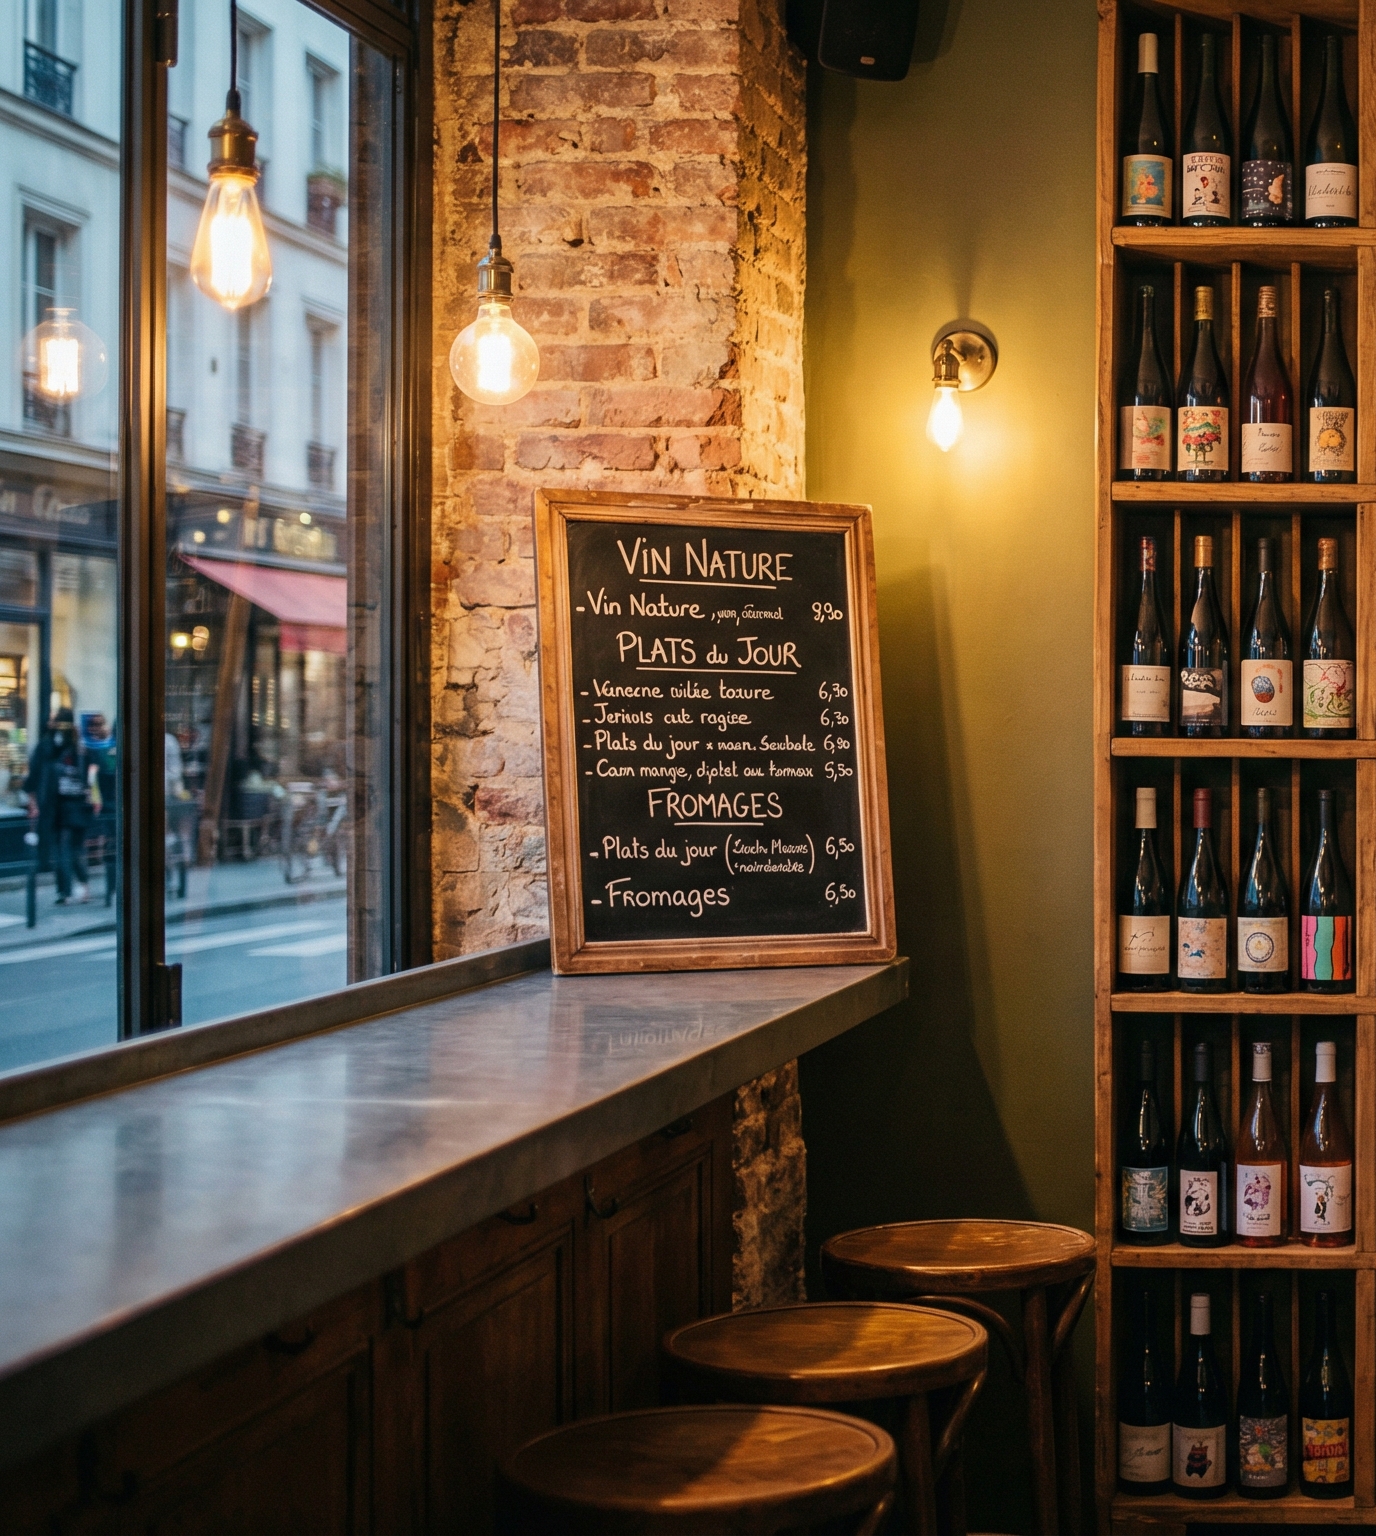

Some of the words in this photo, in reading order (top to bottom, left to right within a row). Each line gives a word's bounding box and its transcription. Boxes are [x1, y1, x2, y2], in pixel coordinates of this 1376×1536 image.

[683, 538, 794, 581] NATURE
[615, 630, 697, 665] PLATS
[706, 643, 729, 665] du
[736, 636, 802, 668] JOUR
[642, 732, 663, 751] du
[665, 734, 700, 760] jour
[647, 787, 783, 820] FROMAGES
[654, 838, 678, 859] du
[680, 840, 718, 867] jour
[825, 836, 855, 860] 6,50
[825, 882, 856, 905] 6,50
